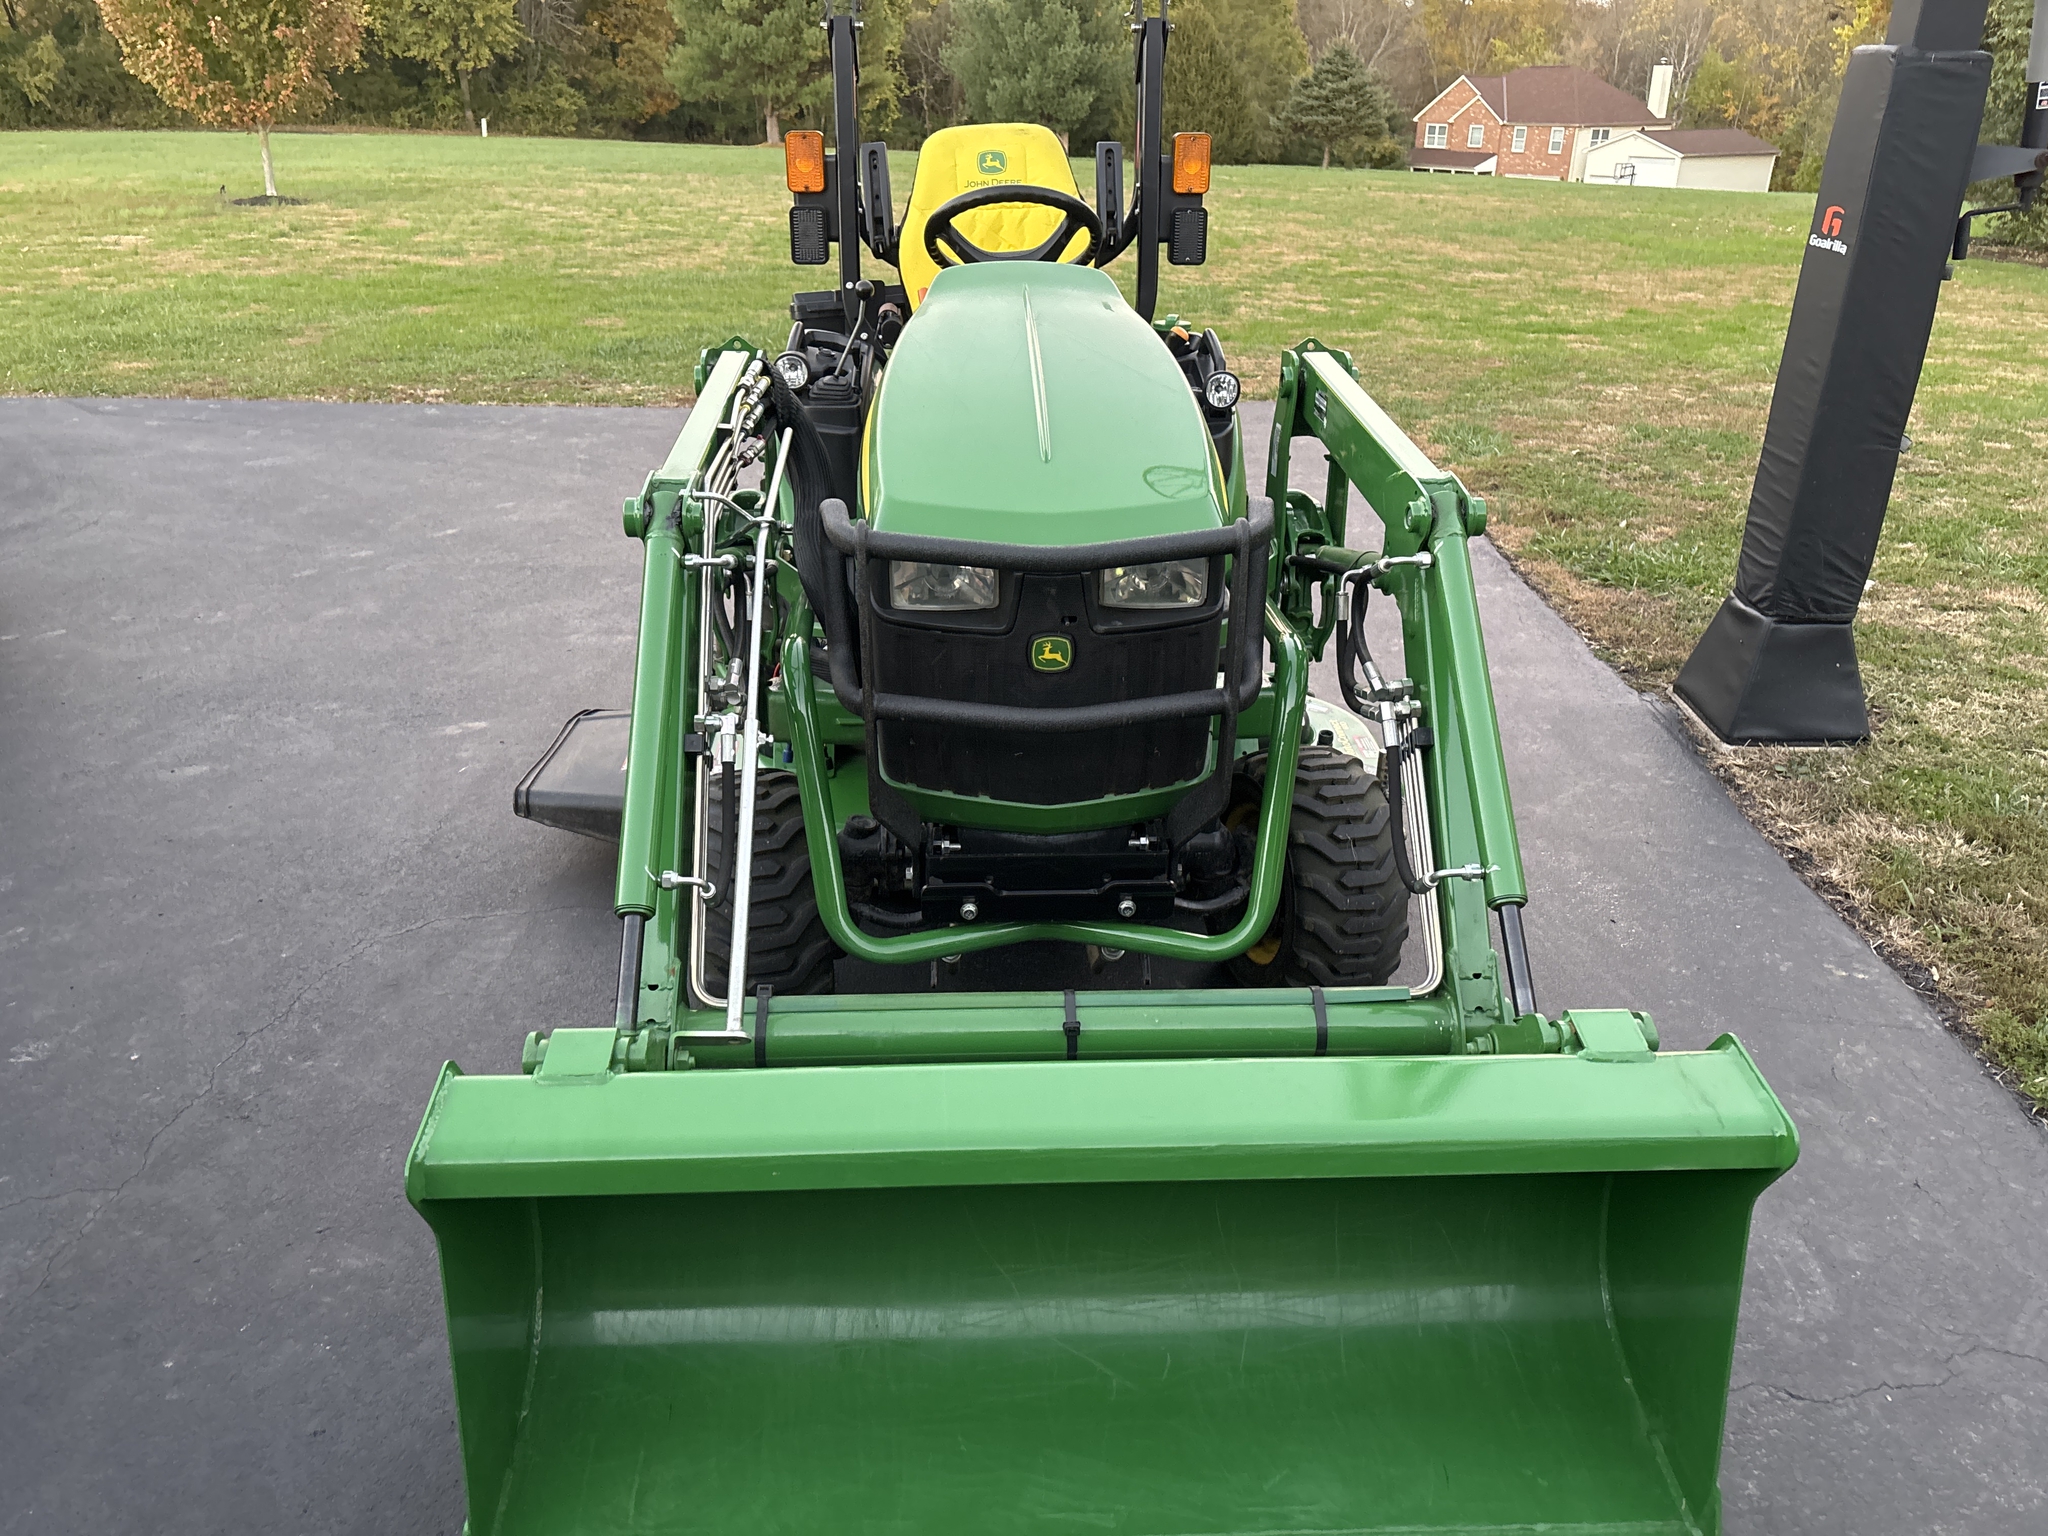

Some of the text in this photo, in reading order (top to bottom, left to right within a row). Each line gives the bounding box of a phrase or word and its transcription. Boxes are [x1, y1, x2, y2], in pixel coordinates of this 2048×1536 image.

[964, 178, 1022, 188] JOHN DEERE
[1809, 234, 1848, 256] Goalrilla
